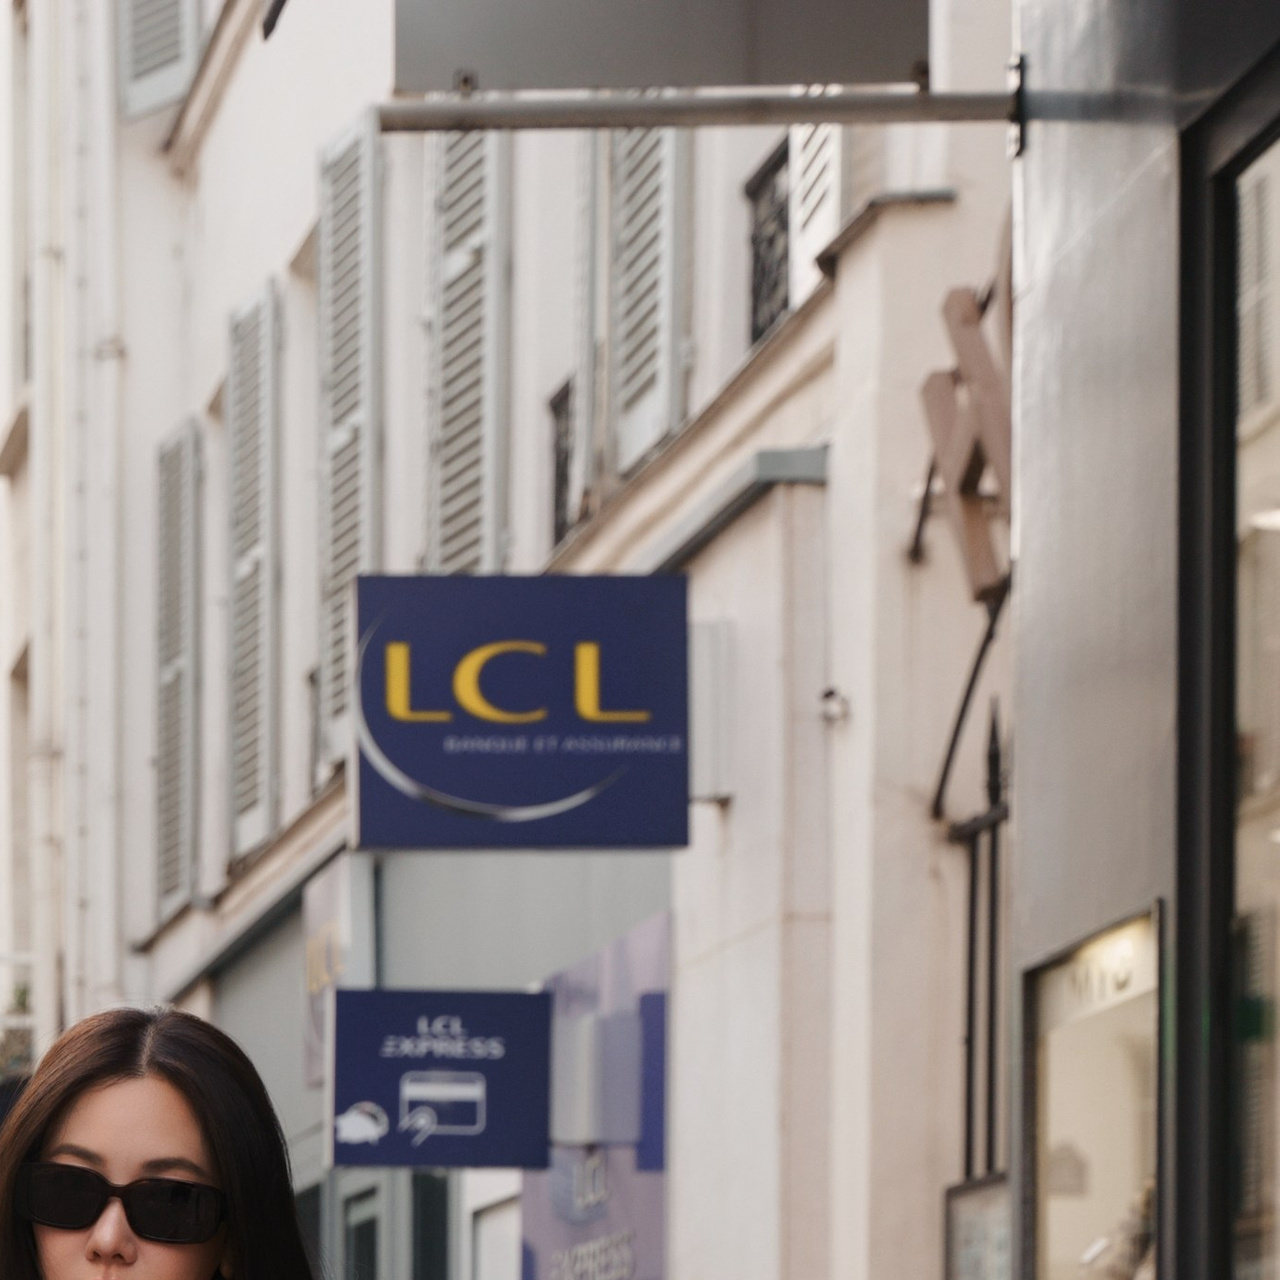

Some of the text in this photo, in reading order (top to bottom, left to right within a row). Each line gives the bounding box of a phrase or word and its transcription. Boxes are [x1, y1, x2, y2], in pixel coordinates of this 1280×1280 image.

[384, 640, 651, 724] LCL
[417, 1015, 469, 1036] LCL
[380, 1034, 506, 1060] EXPRESS
